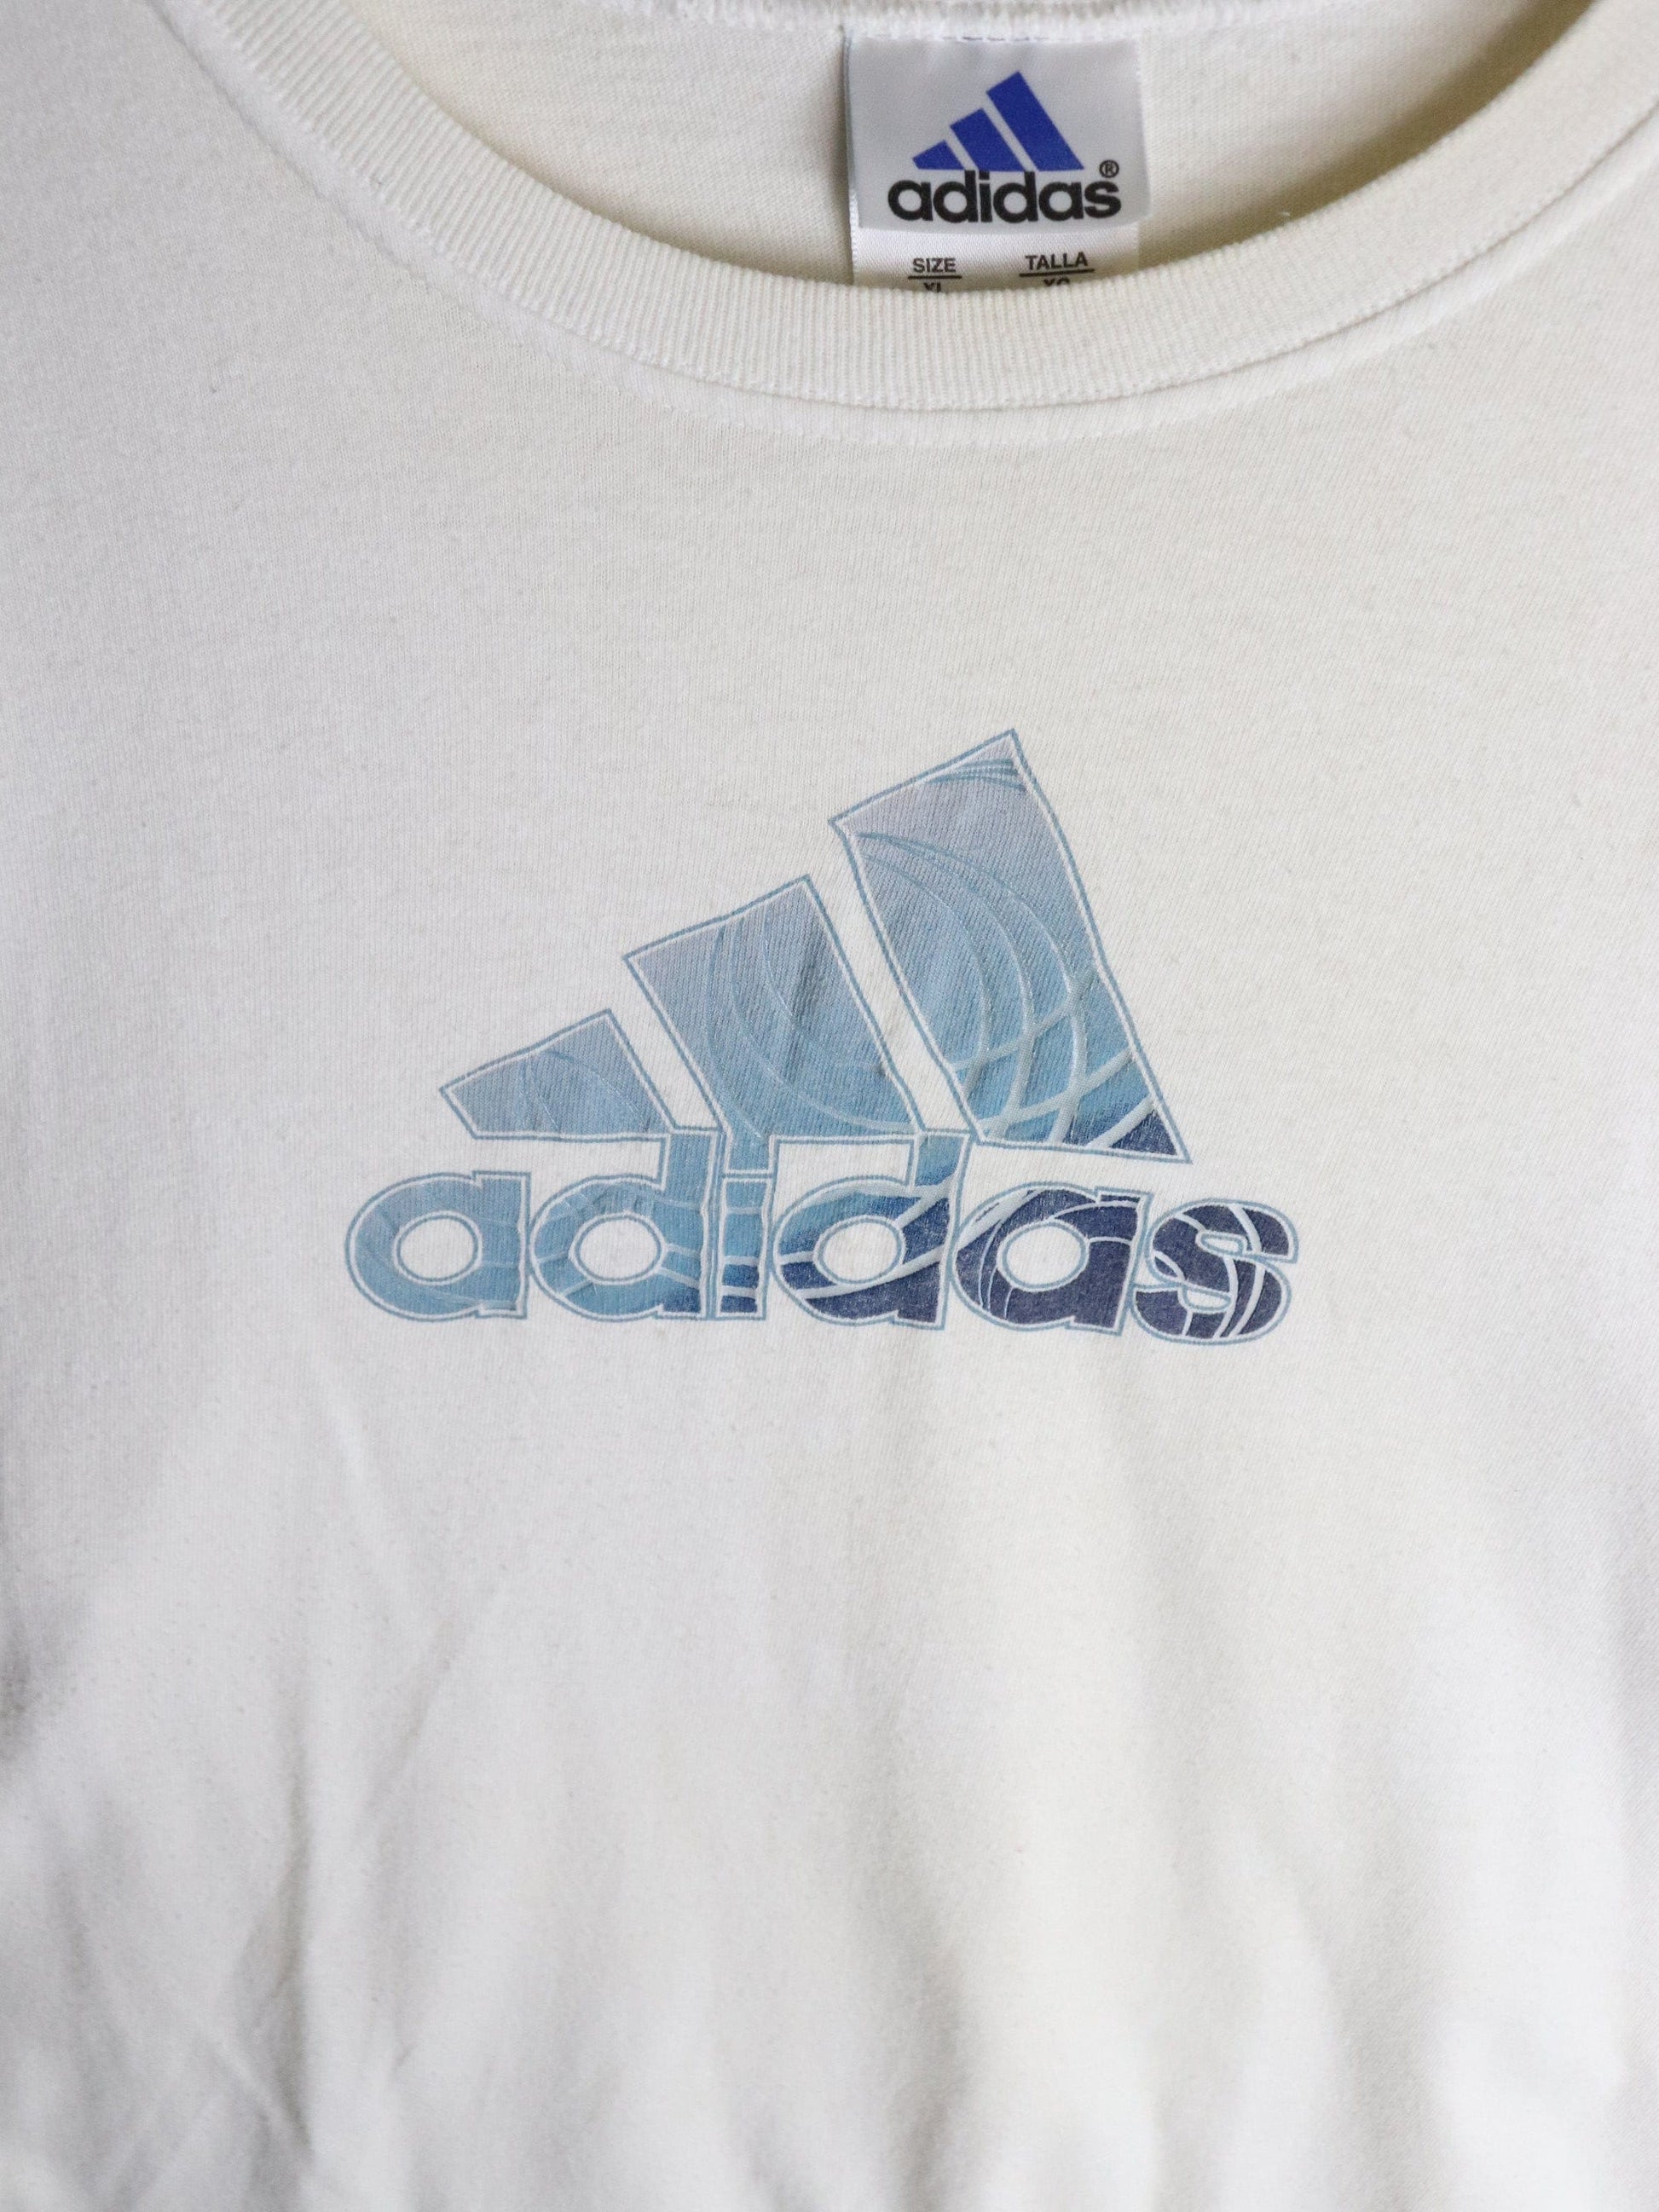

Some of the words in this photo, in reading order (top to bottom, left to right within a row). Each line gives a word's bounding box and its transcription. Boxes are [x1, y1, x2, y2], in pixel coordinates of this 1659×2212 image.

[912, 257, 957, 274] SIZE
[1026, 251, 1089, 270] TALLA
[345, 1128, 1300, 1347] adidas
